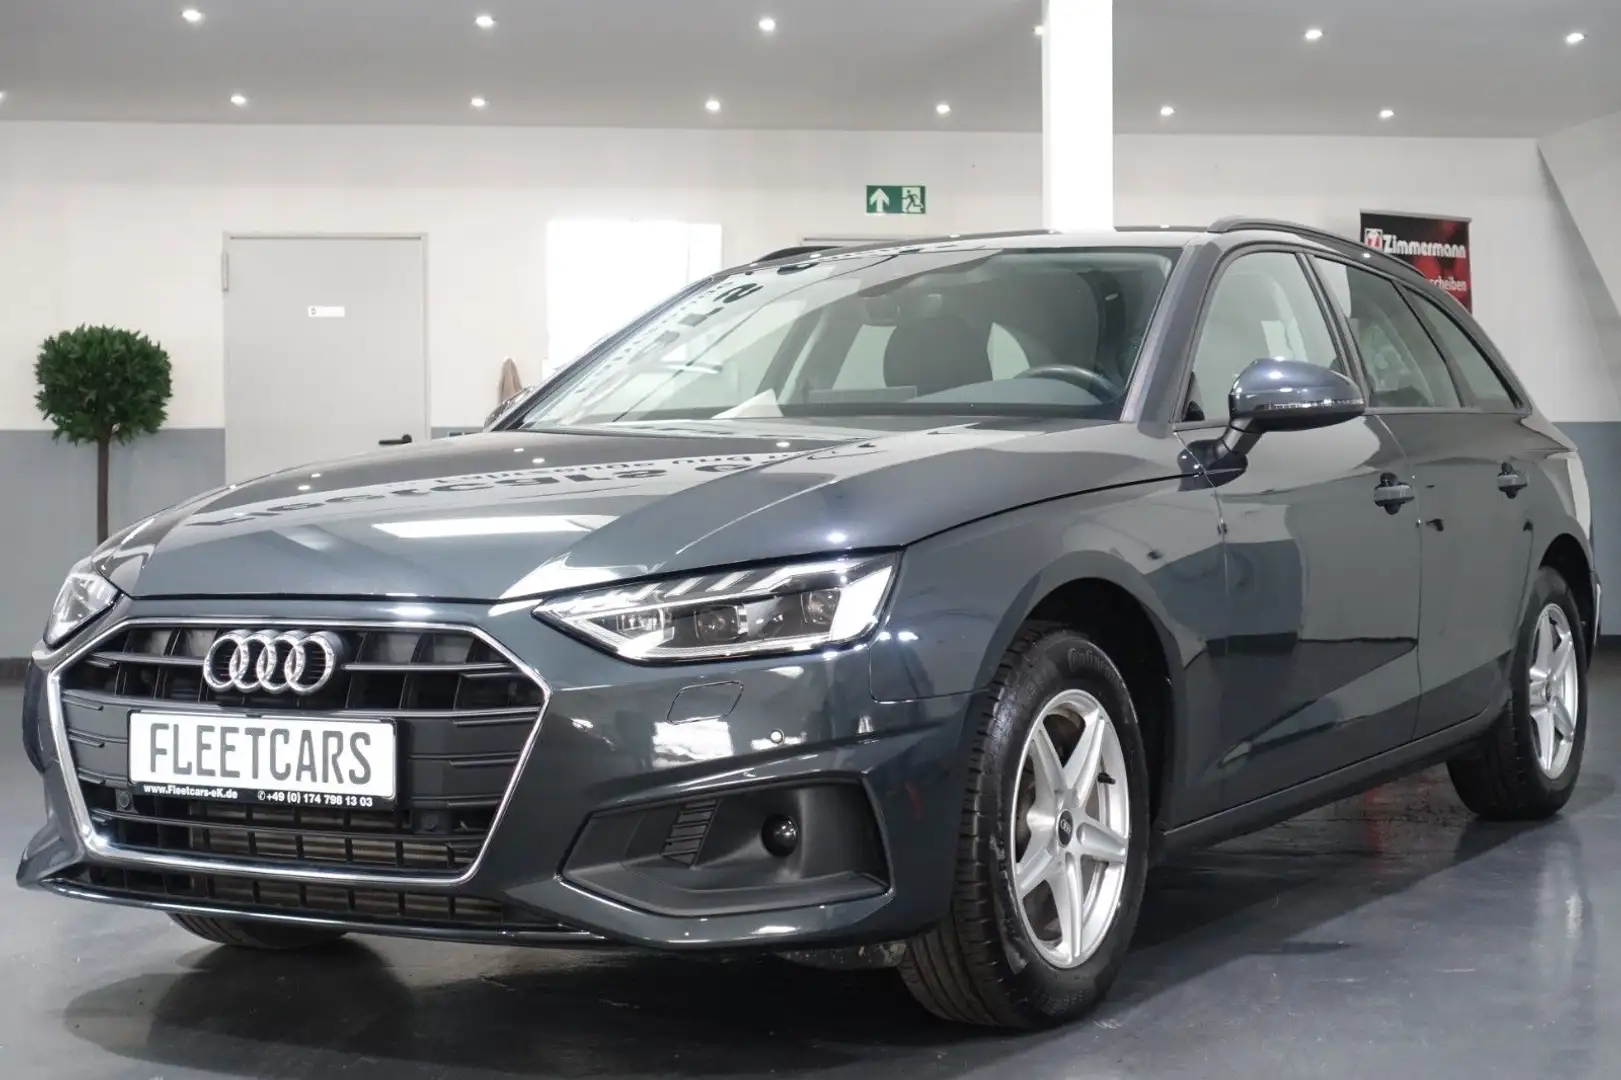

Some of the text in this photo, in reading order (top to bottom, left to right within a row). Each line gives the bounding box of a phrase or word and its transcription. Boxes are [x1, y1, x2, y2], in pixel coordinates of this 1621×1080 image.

[1383, 234, 1466, 258] Zimmermann
[150, 723, 372, 785] FLEETCARS
[143, 784, 238, 799] www.Fleetcars-eK.de
[266, 791, 373, 807] +49 (0) 174 798 13 03
